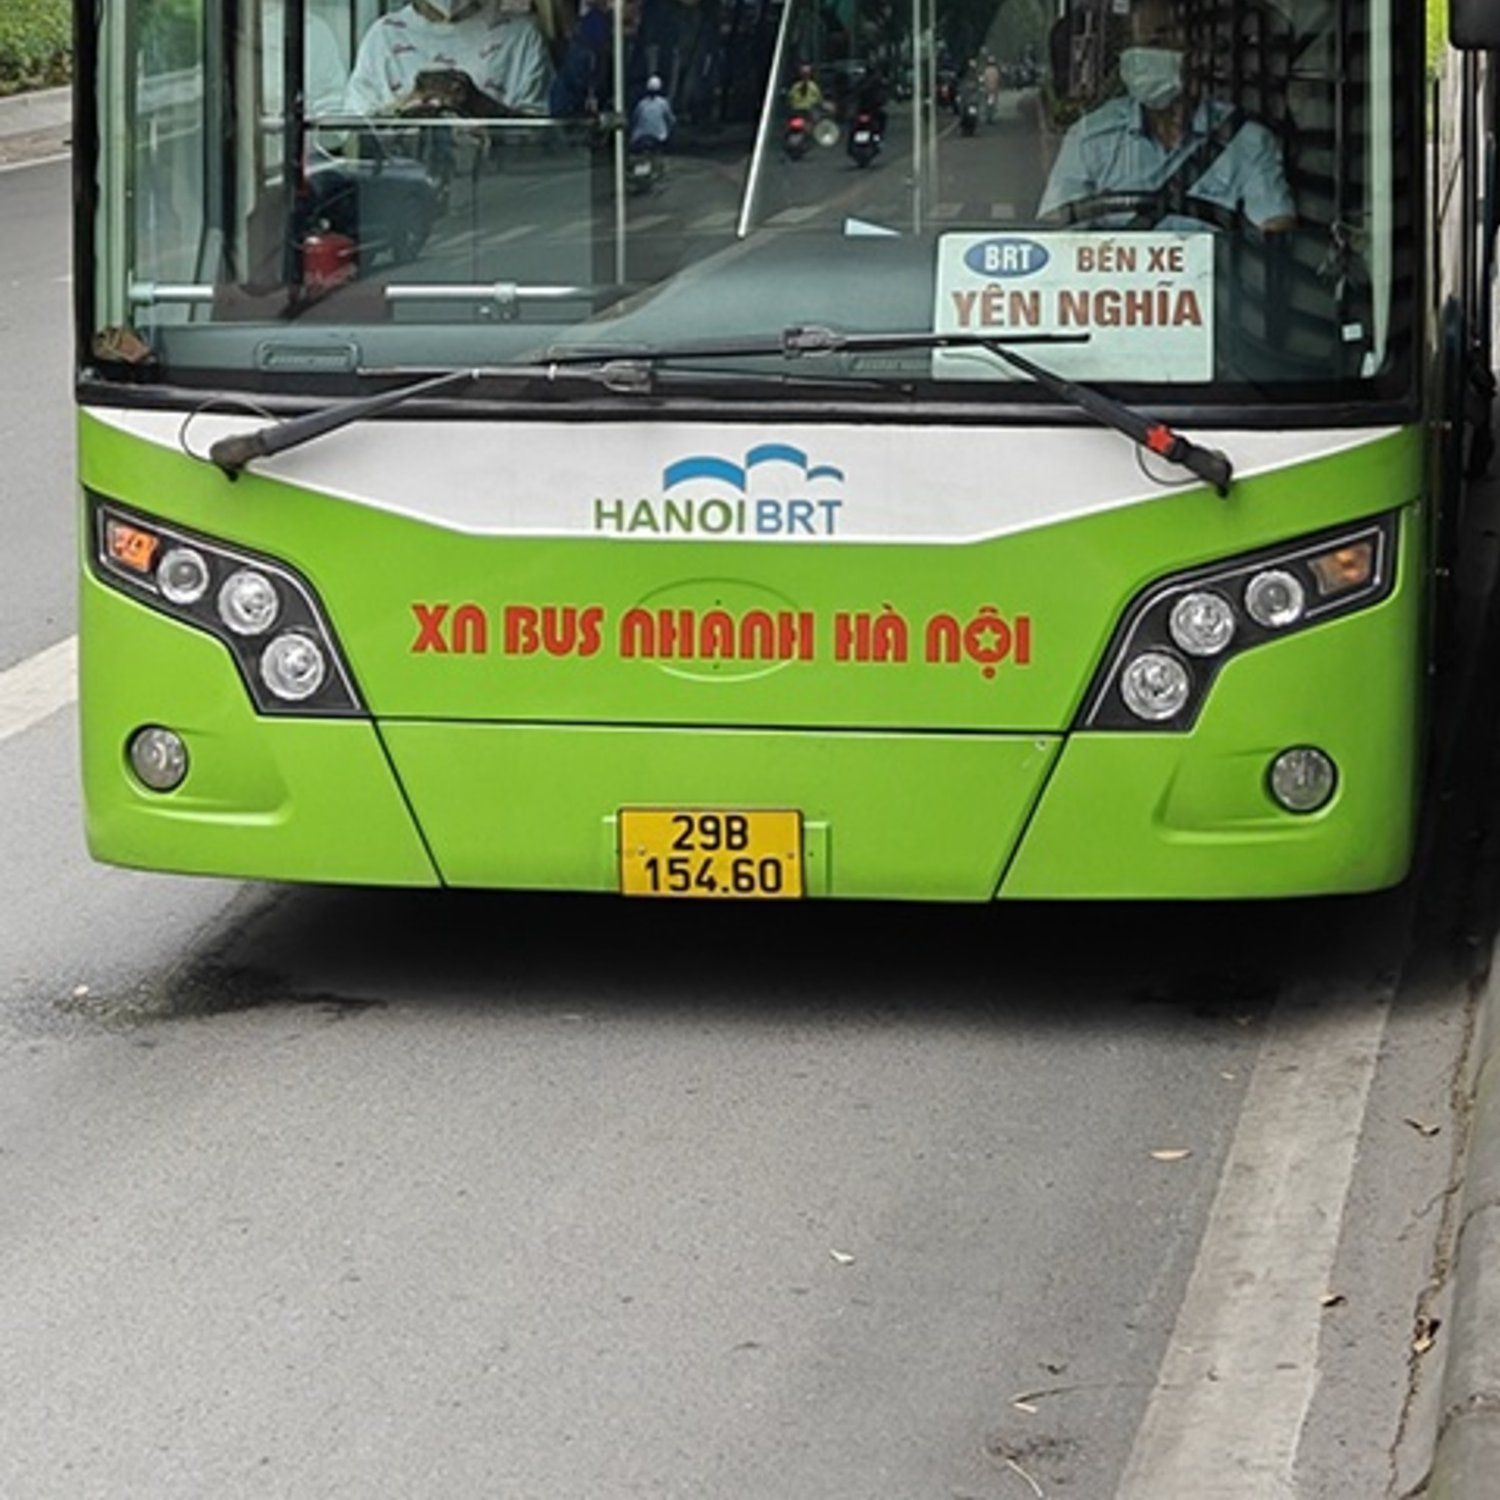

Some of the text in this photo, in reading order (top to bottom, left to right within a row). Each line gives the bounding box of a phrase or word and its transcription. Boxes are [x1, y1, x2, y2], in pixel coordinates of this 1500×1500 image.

[984, 238, 1184, 272] BRT BẾN XE
[952, 281, 1203, 326] YÊN NGHĨA
[594, 499, 842, 534] HANOI BRT
[411, 603, 1031, 680] XN BUS NHANH HÀ NỘI
[672, 815, 748, 851] 29B
[645, 857, 782, 893] 154.60
